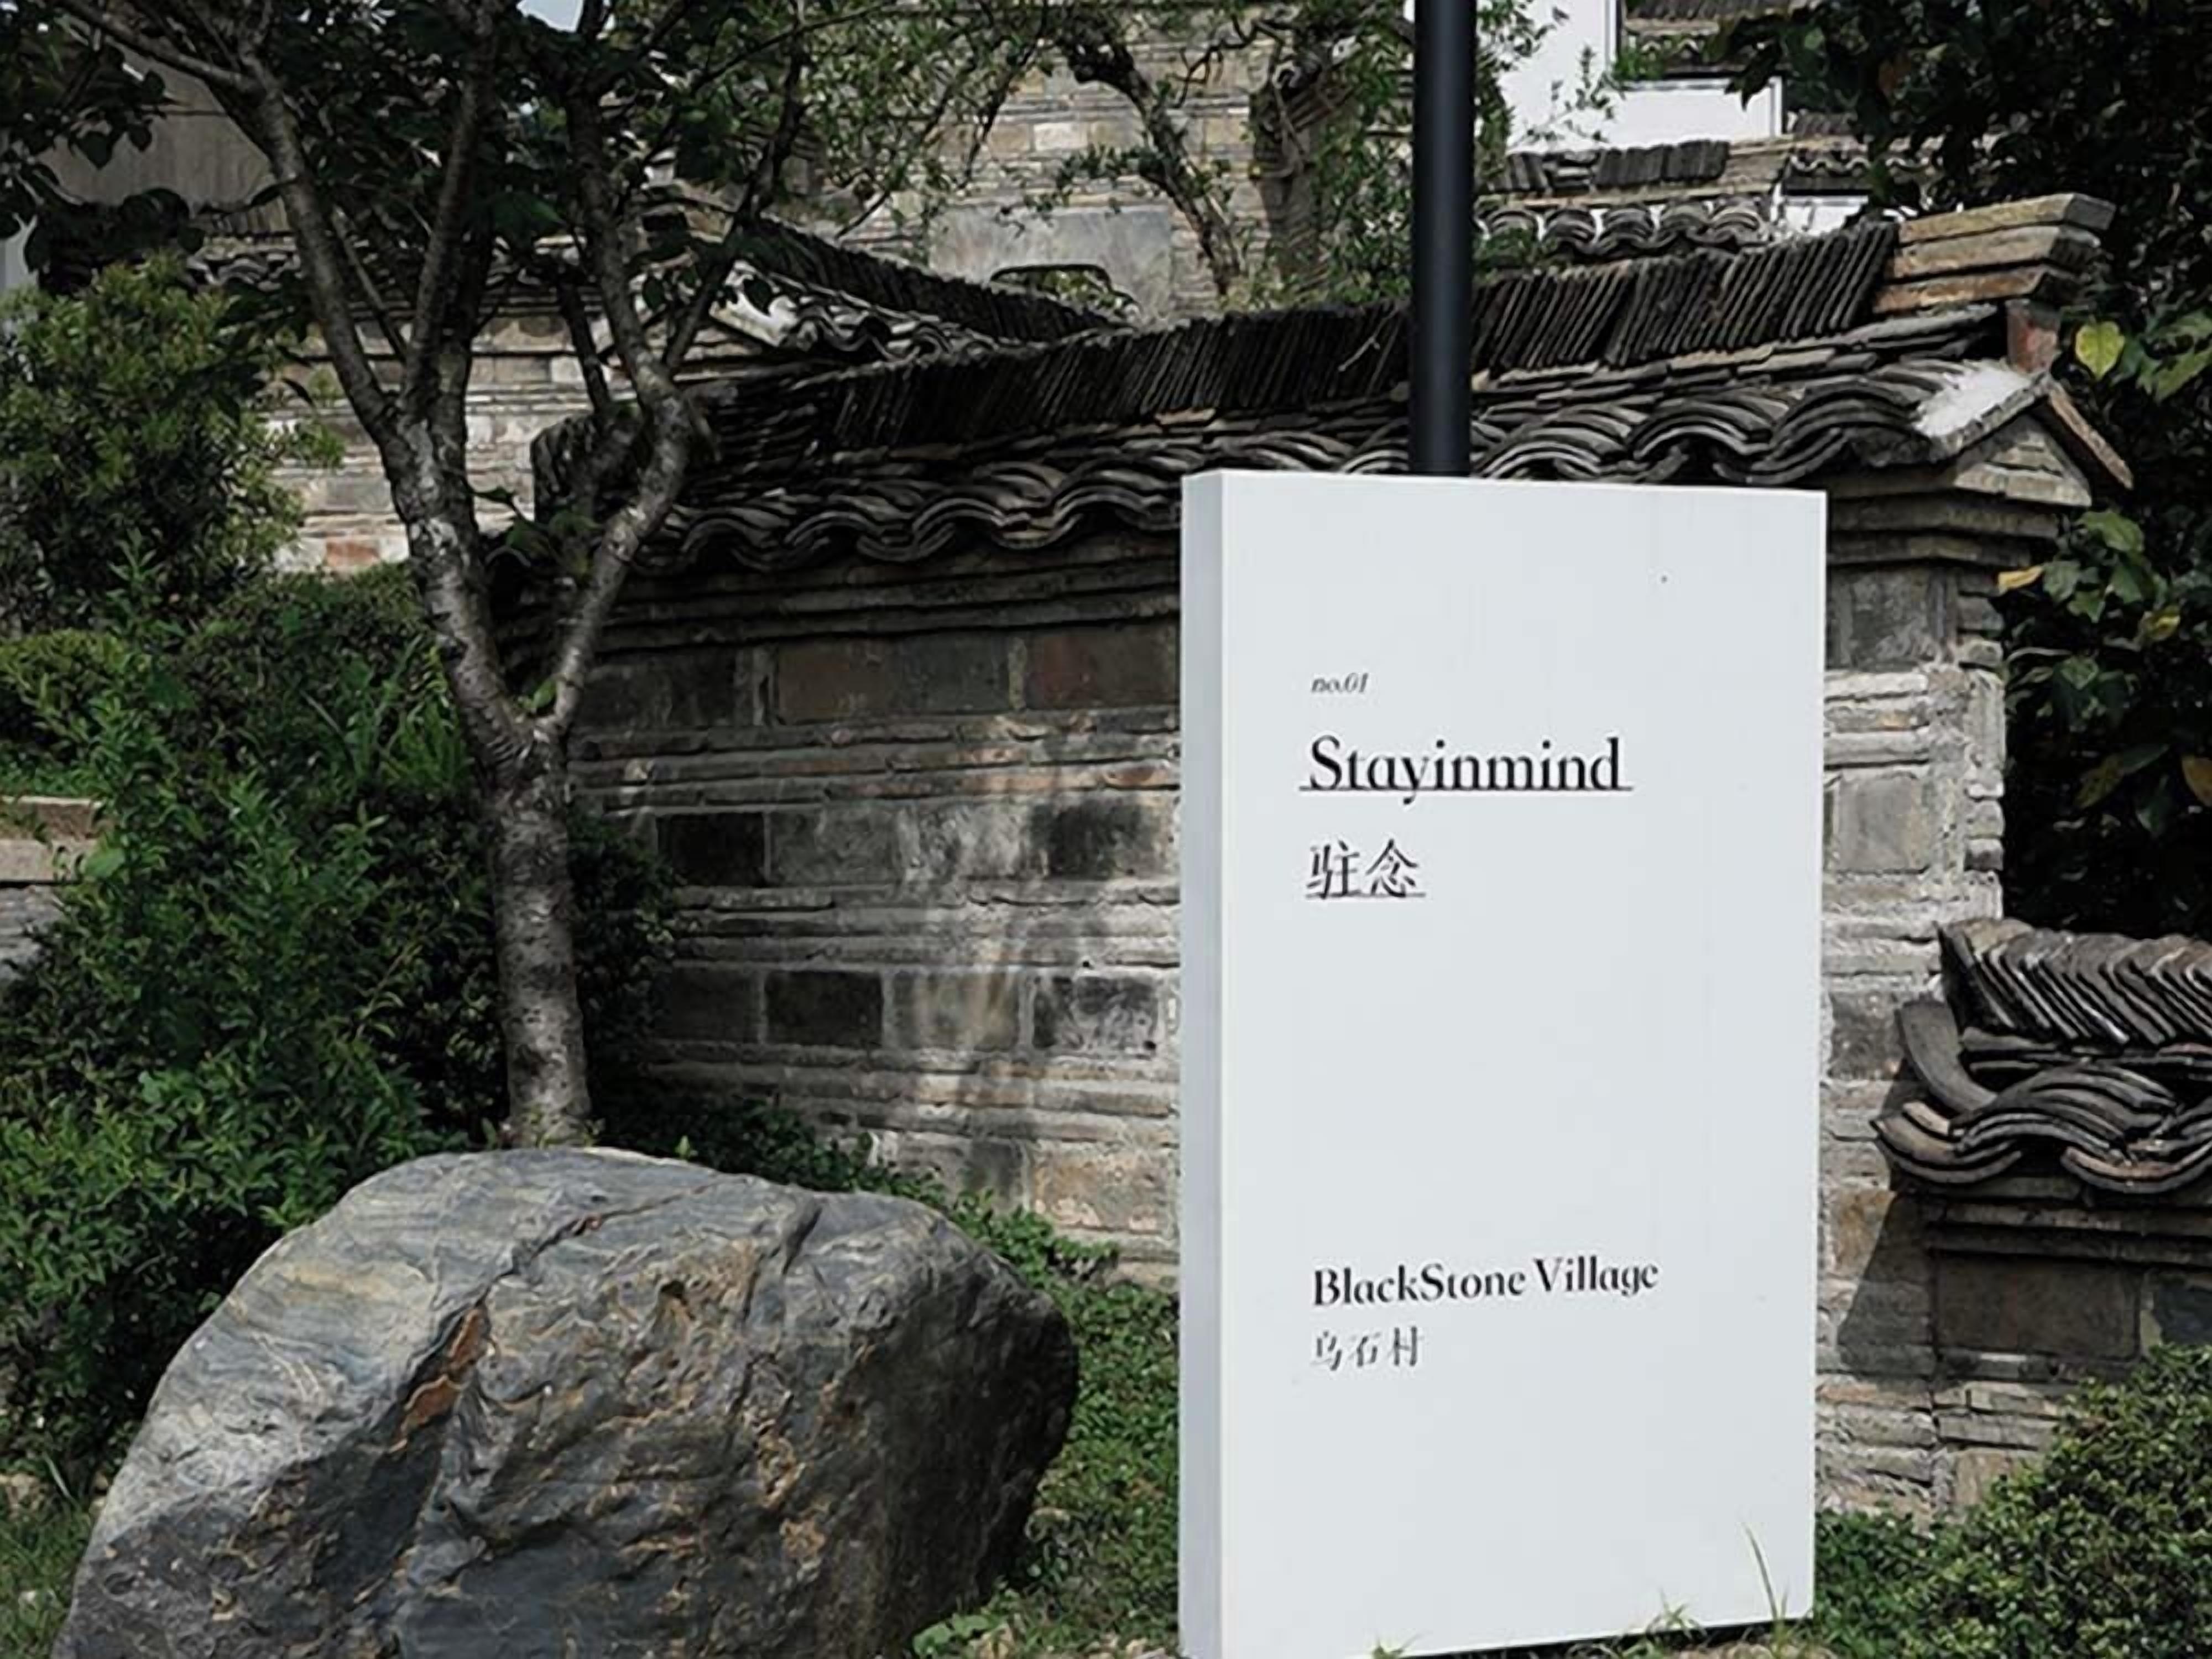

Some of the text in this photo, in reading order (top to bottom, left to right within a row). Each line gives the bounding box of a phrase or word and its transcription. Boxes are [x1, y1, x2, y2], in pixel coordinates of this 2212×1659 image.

[1311, 672, 1369, 693] no.01
[1310, 734, 1619, 805] Stayinmind
[1306, 838, 1420, 899] 驻念
[1314, 1255, 1658, 1306] BlackStone Village
[1311, 1327, 1423, 1371] 乌石村
